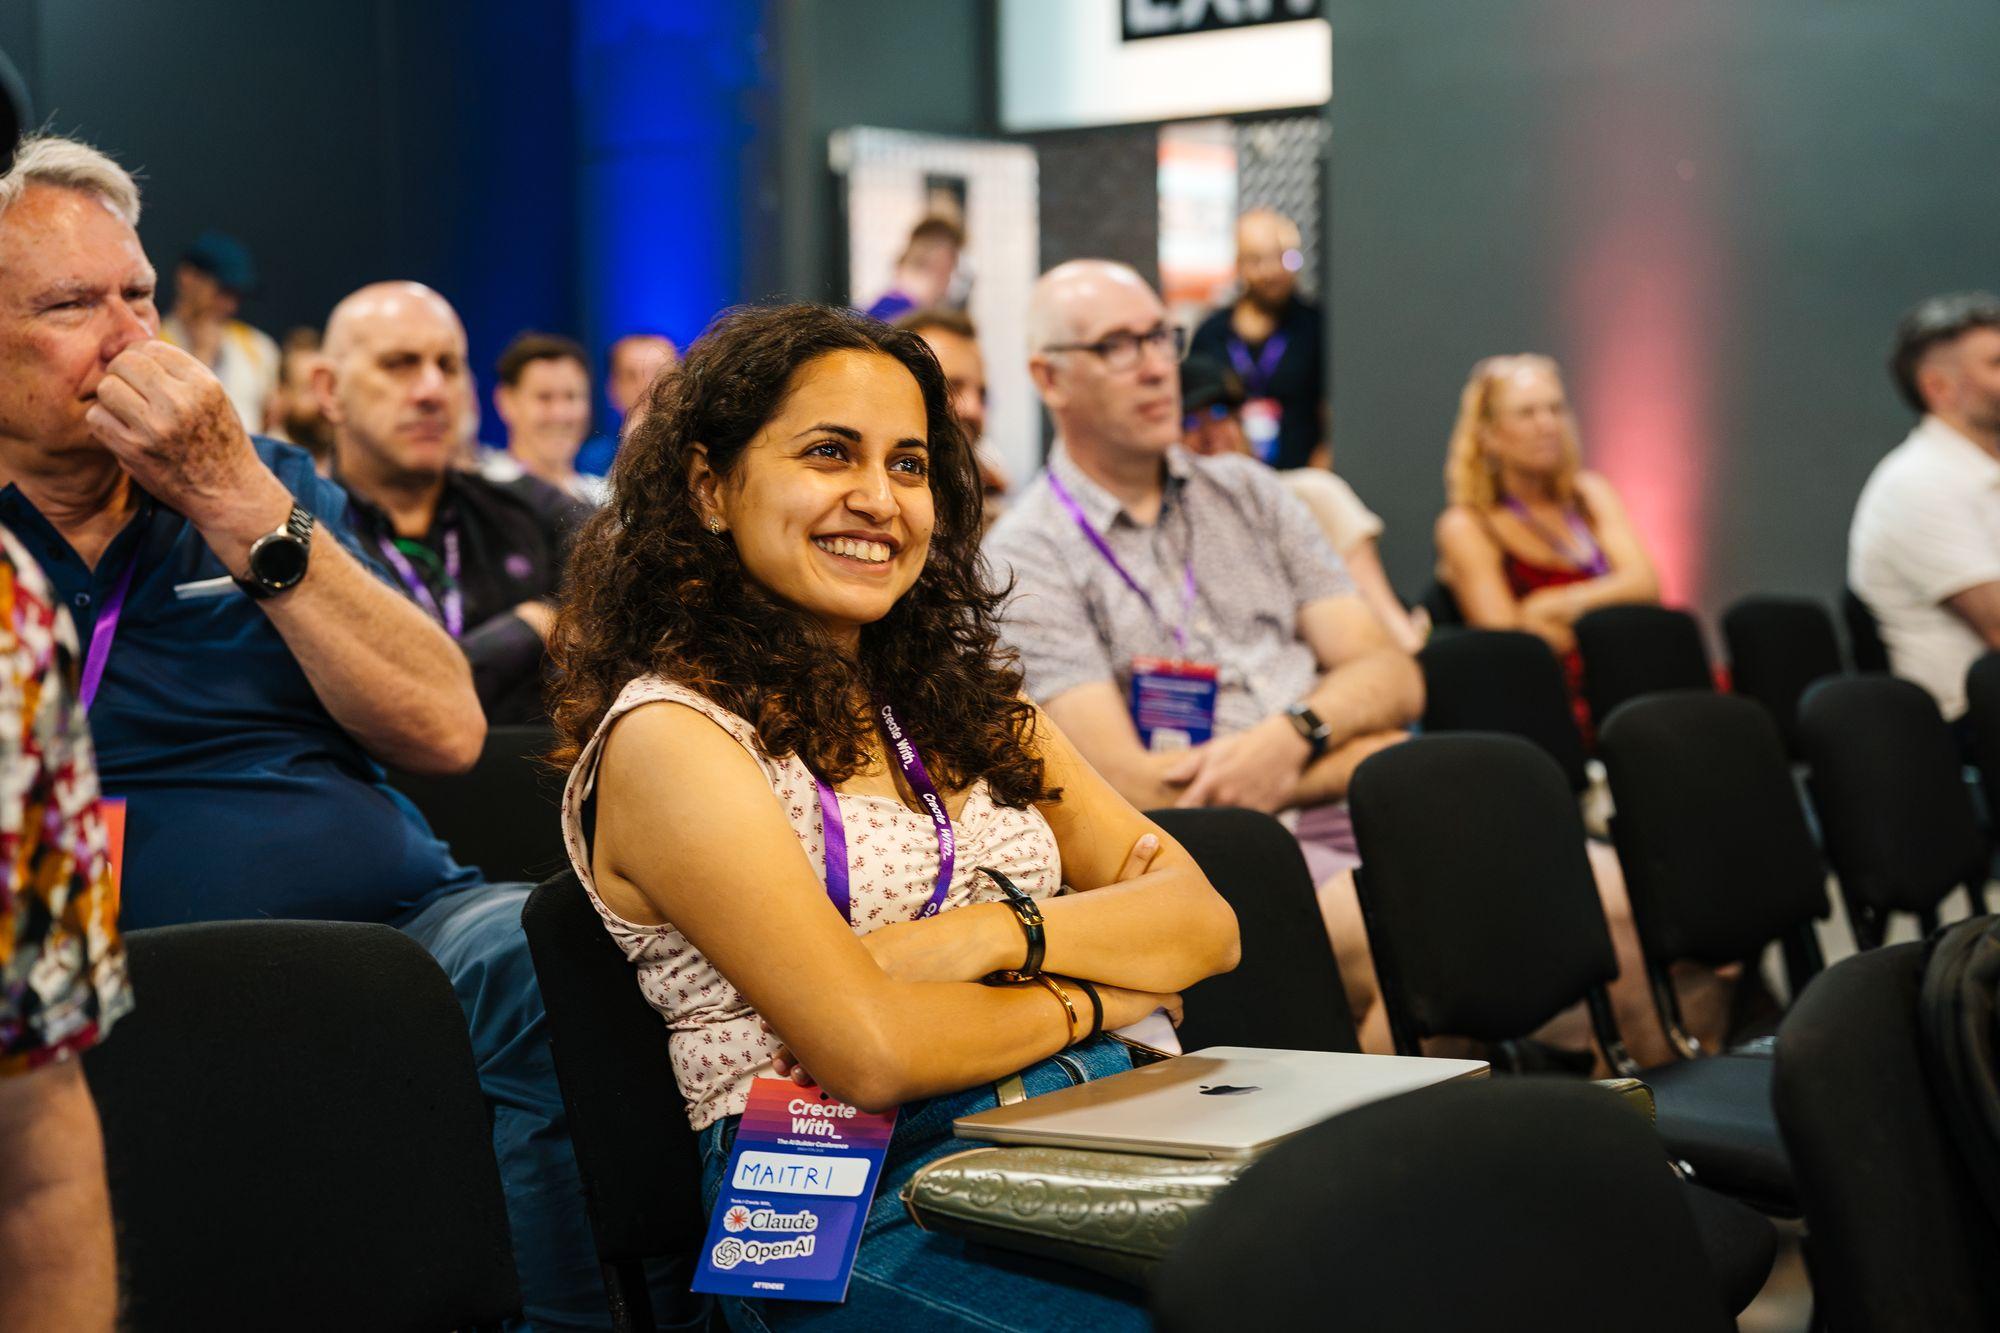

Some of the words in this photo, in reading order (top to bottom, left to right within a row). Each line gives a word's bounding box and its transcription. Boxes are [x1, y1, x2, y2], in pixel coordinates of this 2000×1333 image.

[881, 704, 902, 740] Create
[922, 793, 947, 825] Create
[788, 1098, 857, 1119] Create
[741, 1163, 833, 1190] MAITRI
[750, 1212, 815, 1230] Claude
[745, 1238, 812, 1261] OpenAI
